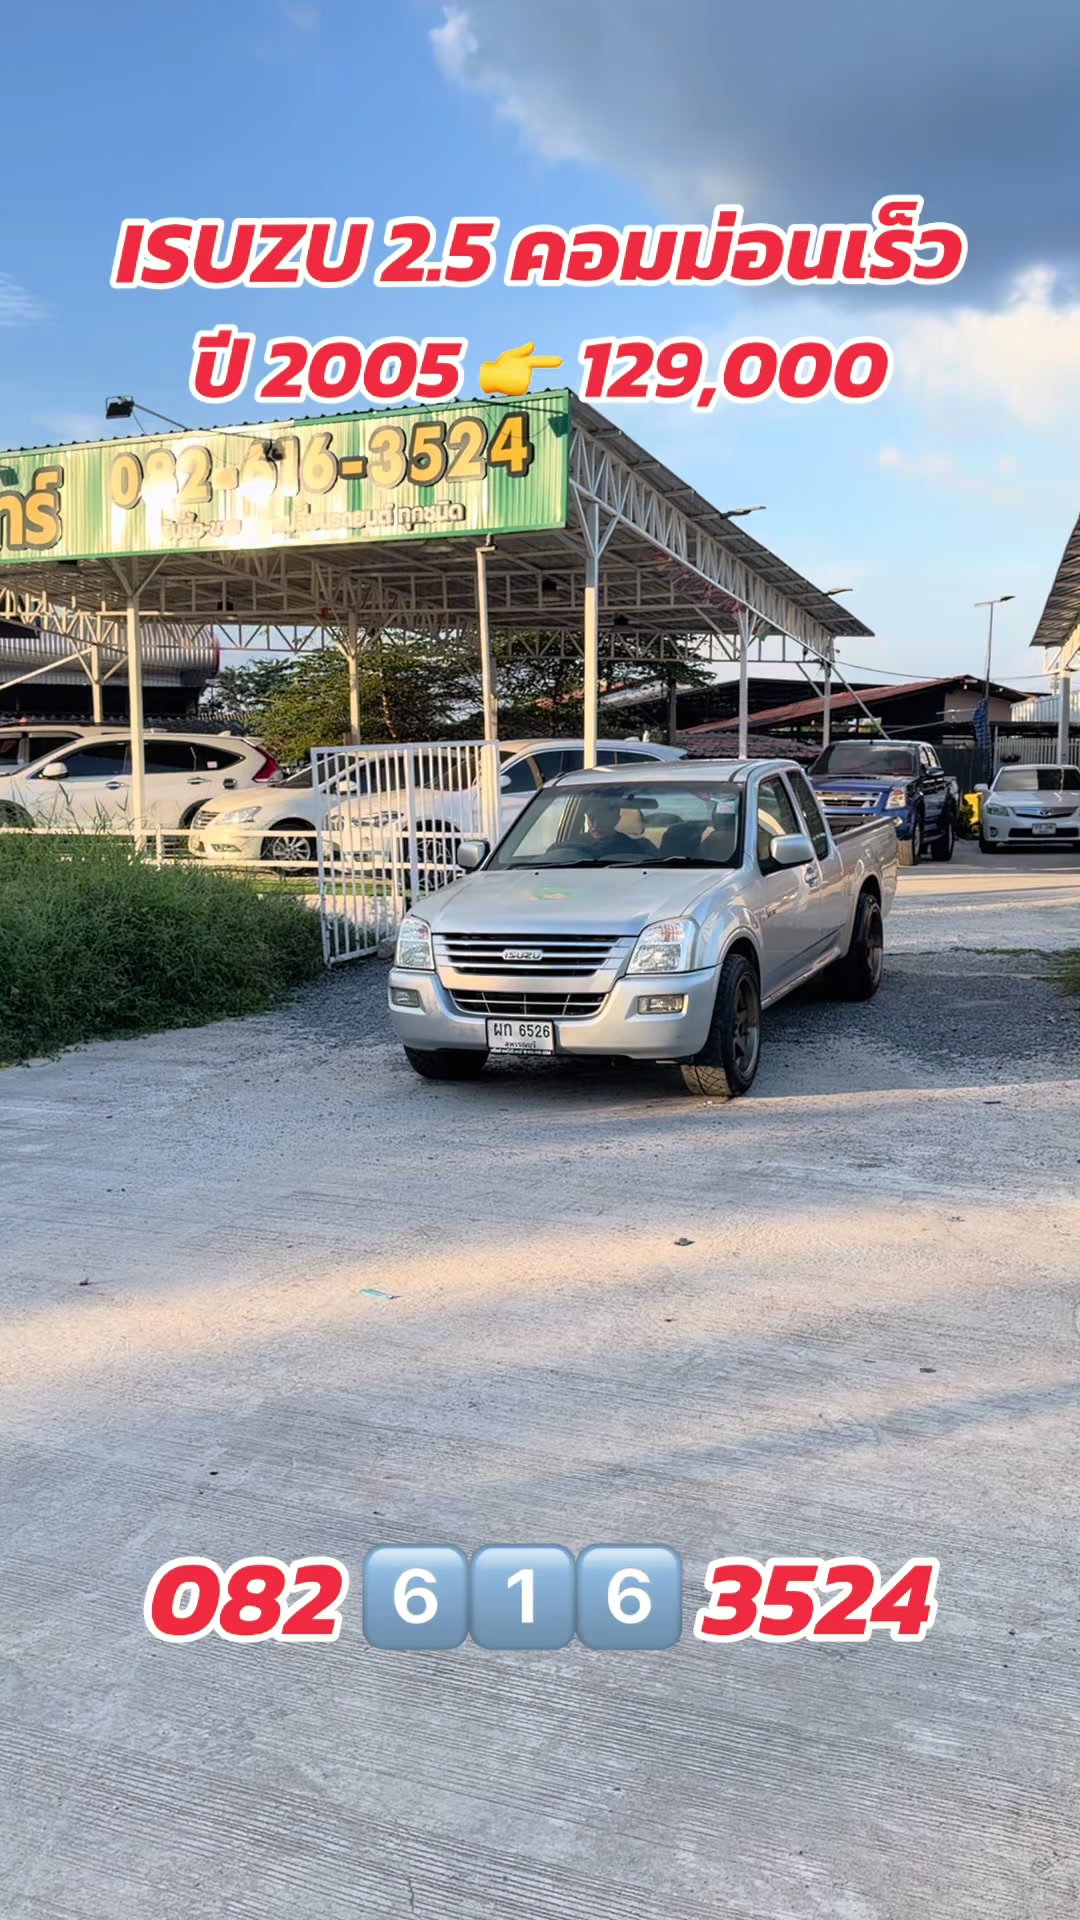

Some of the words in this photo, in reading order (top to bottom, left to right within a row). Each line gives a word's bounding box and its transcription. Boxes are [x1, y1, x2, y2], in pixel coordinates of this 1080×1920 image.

[109, 411, 534, 509] 082-616-3524
[503, 950, 542, 960] ISUZU
[518, 1023, 551, 1039] 6526
